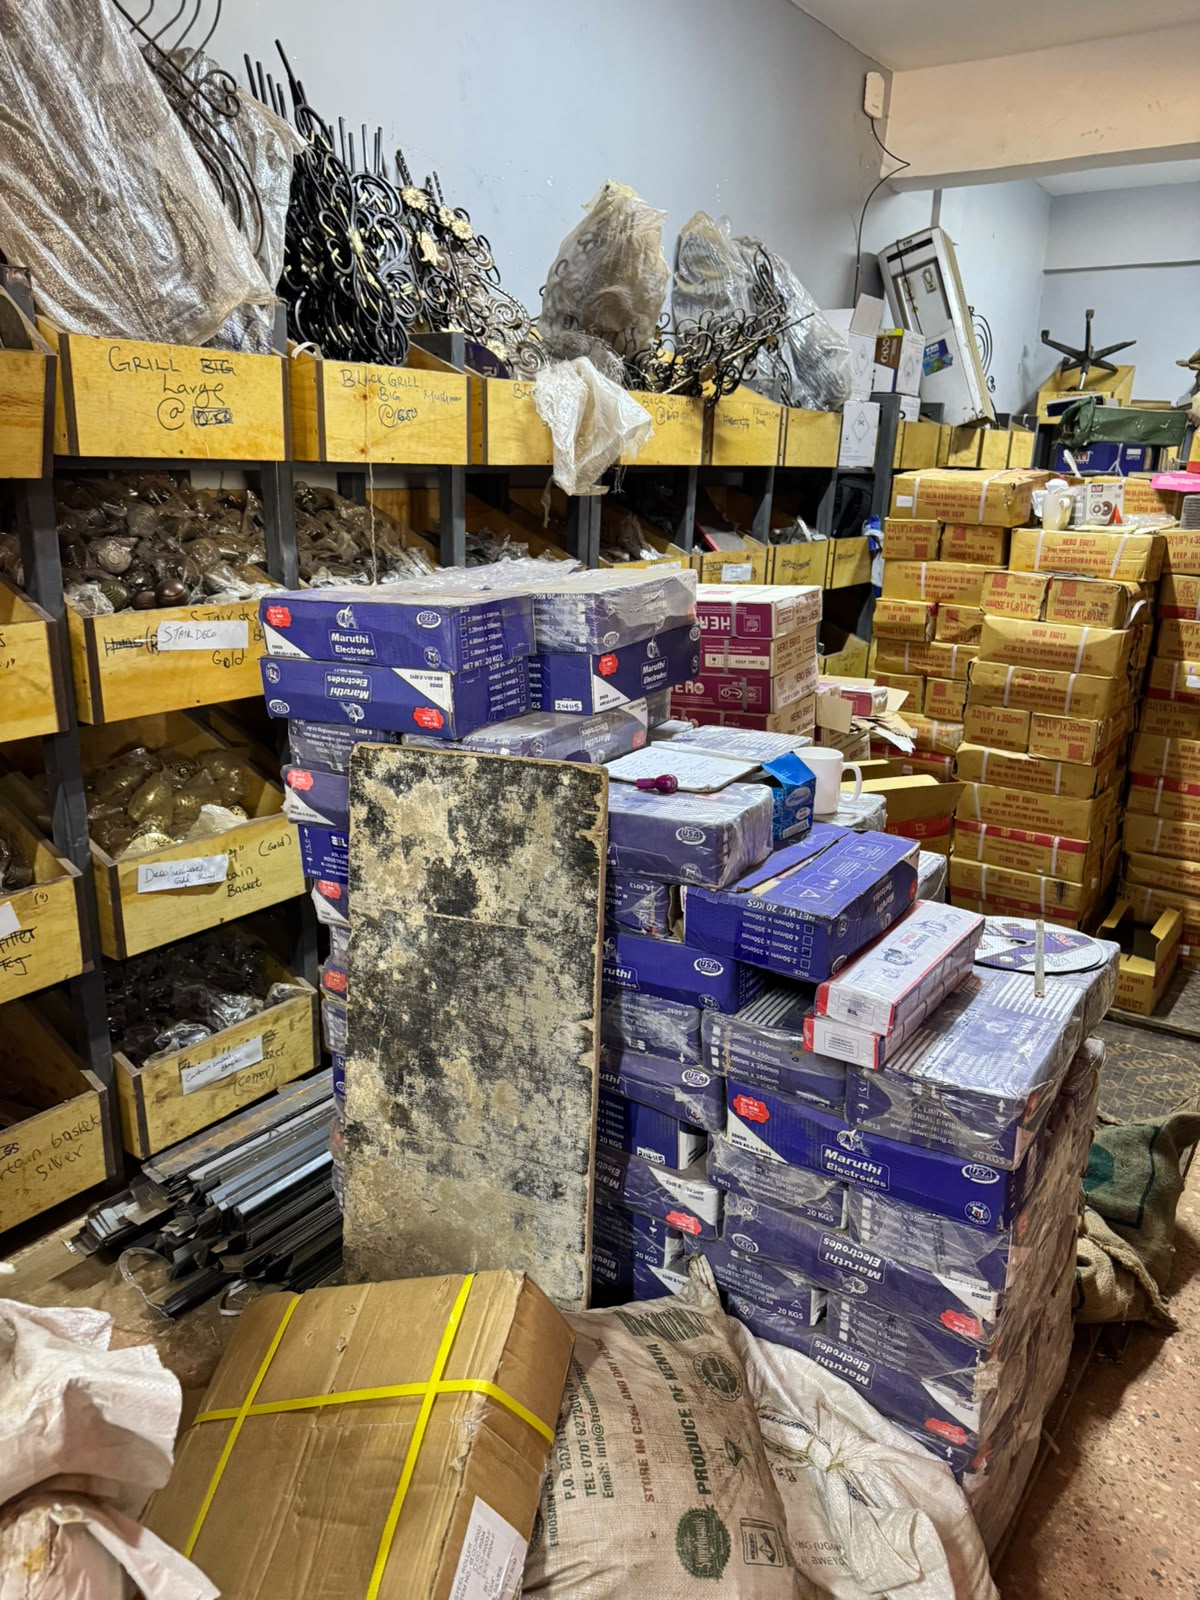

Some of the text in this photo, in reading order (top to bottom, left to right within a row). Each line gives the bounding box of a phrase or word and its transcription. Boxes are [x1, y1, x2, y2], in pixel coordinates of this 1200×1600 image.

[108, 346, 182, 374] GRILL
[388, 373, 420, 389] GRILL
[699, 615, 731, 631] HER
[330, 632, 369, 644] Maruthi
[334, 645, 375, 656] Electrodes
[492, 654, 503, 663] KGS
[642, 660, 666, 674] Maruthi
[327, 675, 368, 687] Electrodes
[643, 671, 667, 685] Electrodes
[329, 686, 369, 699] Maruthi
[672, 681, 705, 695] ERO
[980, 727, 994, 736] KEEP
[681, 829, 700, 840] USA
[746, 898, 816, 922] NET 20 KGS
[742, 922, 766, 933] 350mm
[740, 943, 764, 955] 350mm
[741, 932, 798, 953] 3.20mm 350mm
[603, 966, 632, 980] ruthi
[699, 960, 719, 971] USA
[732, 1032, 782, 1052] .50mm 350mm
[731, 1043, 780, 1065] .20mm 350mm
[756, 1061, 780, 1075] 350mm
[599, 1072, 620, 1085] uthi
[686, 1071, 705, 1082] USA
[755, 1073, 780, 1086] 350mm
[609, 1139, 623, 1150] KGS
[824, 1148, 883, 1176] Maruthi
[826, 1161, 887, 1188] Electrodes
[968, 1165, 993, 1180] USA
[807, 1208, 835, 1223] 20 KGS
[635, 1251, 658, 1265] 20 KGS
[823, 1236, 882, 1268] Electrodes
[824, 1252, 882, 1281] Maruthi
[777, 1306, 804, 1321] 20 KGS
[814, 1339, 871, 1372] Electrodes
[608, 1360, 624, 1380] DRY
[815, 1354, 870, 1386] Maruthi
[616, 1380, 634, 1401] AND
[568, 1394, 587, 1437] 627200
[645, 1343, 712, 1496] PRODUCE OF KENYA
[635, 1438, 646, 1455] IN
[562, 1474, 577, 1501] P.O.
[584, 1472, 598, 1497] TEL:
[637, 1458, 655, 1503] STORE
